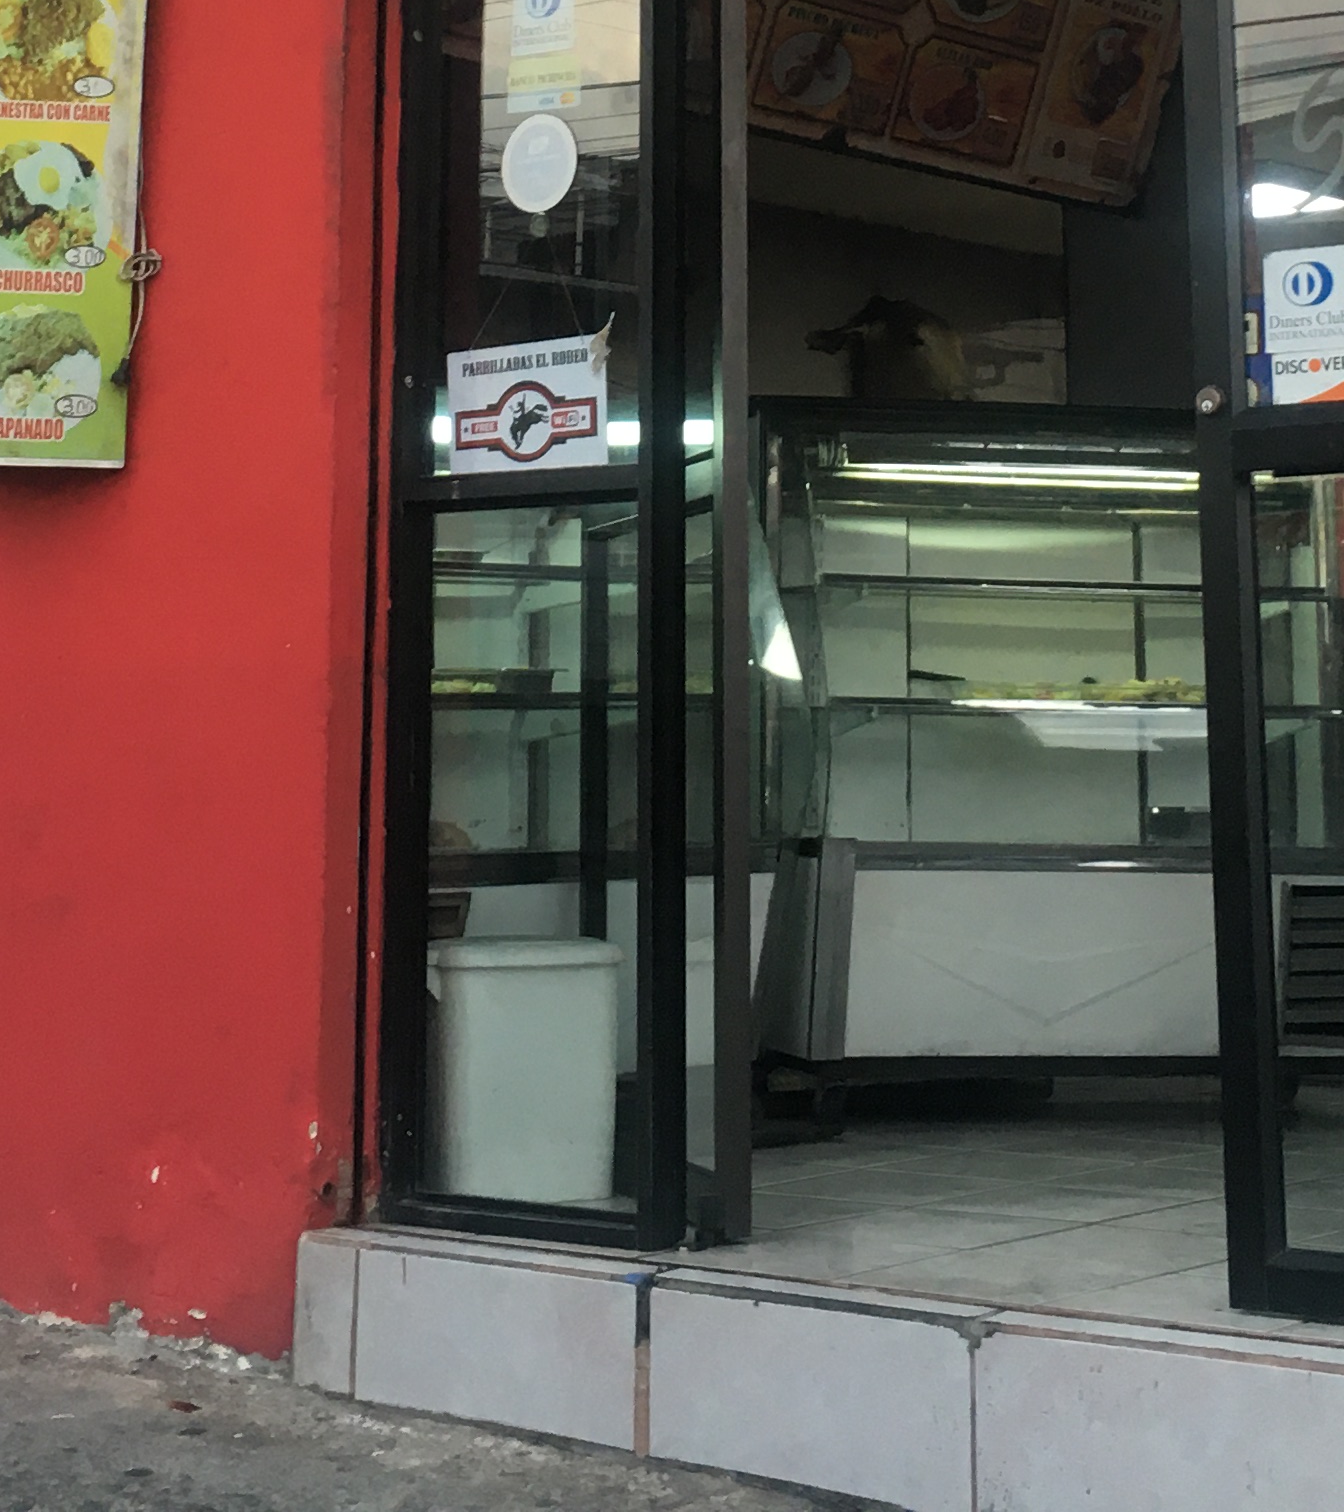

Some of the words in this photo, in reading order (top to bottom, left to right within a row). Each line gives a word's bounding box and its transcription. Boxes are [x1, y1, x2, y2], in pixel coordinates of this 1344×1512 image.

[47, 103, 71, 120] CON
[73, 104, 111, 122] CARNE
[1268, 314, 1312, 330] Diners
[462, 353, 534, 377] PARRILLADAS
[536, 353, 550, 369] EL
[551, 348, 588, 366] RODEO
